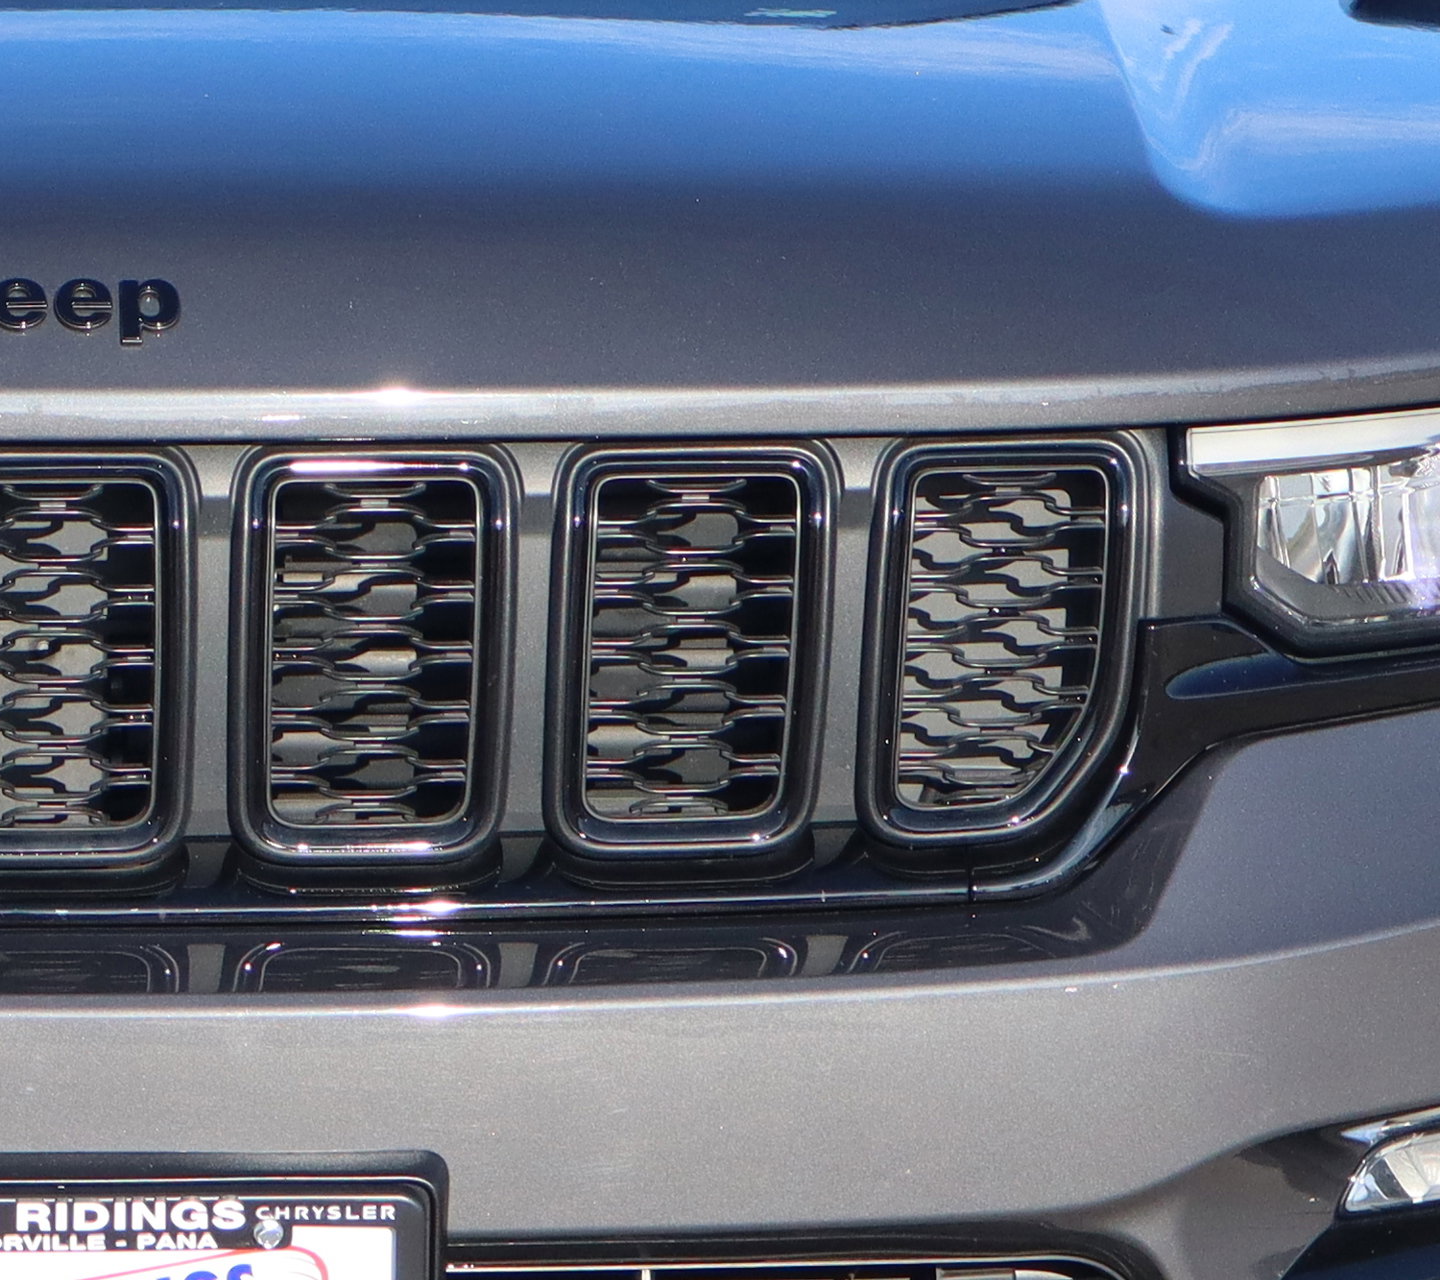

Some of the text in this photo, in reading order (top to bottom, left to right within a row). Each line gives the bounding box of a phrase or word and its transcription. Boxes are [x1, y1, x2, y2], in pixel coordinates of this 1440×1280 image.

[15, 1199, 247, 1232] RIDINGS
[255, 1205, 396, 1221] CHRYSLER
[136, 1231, 219, 1251] PANA
